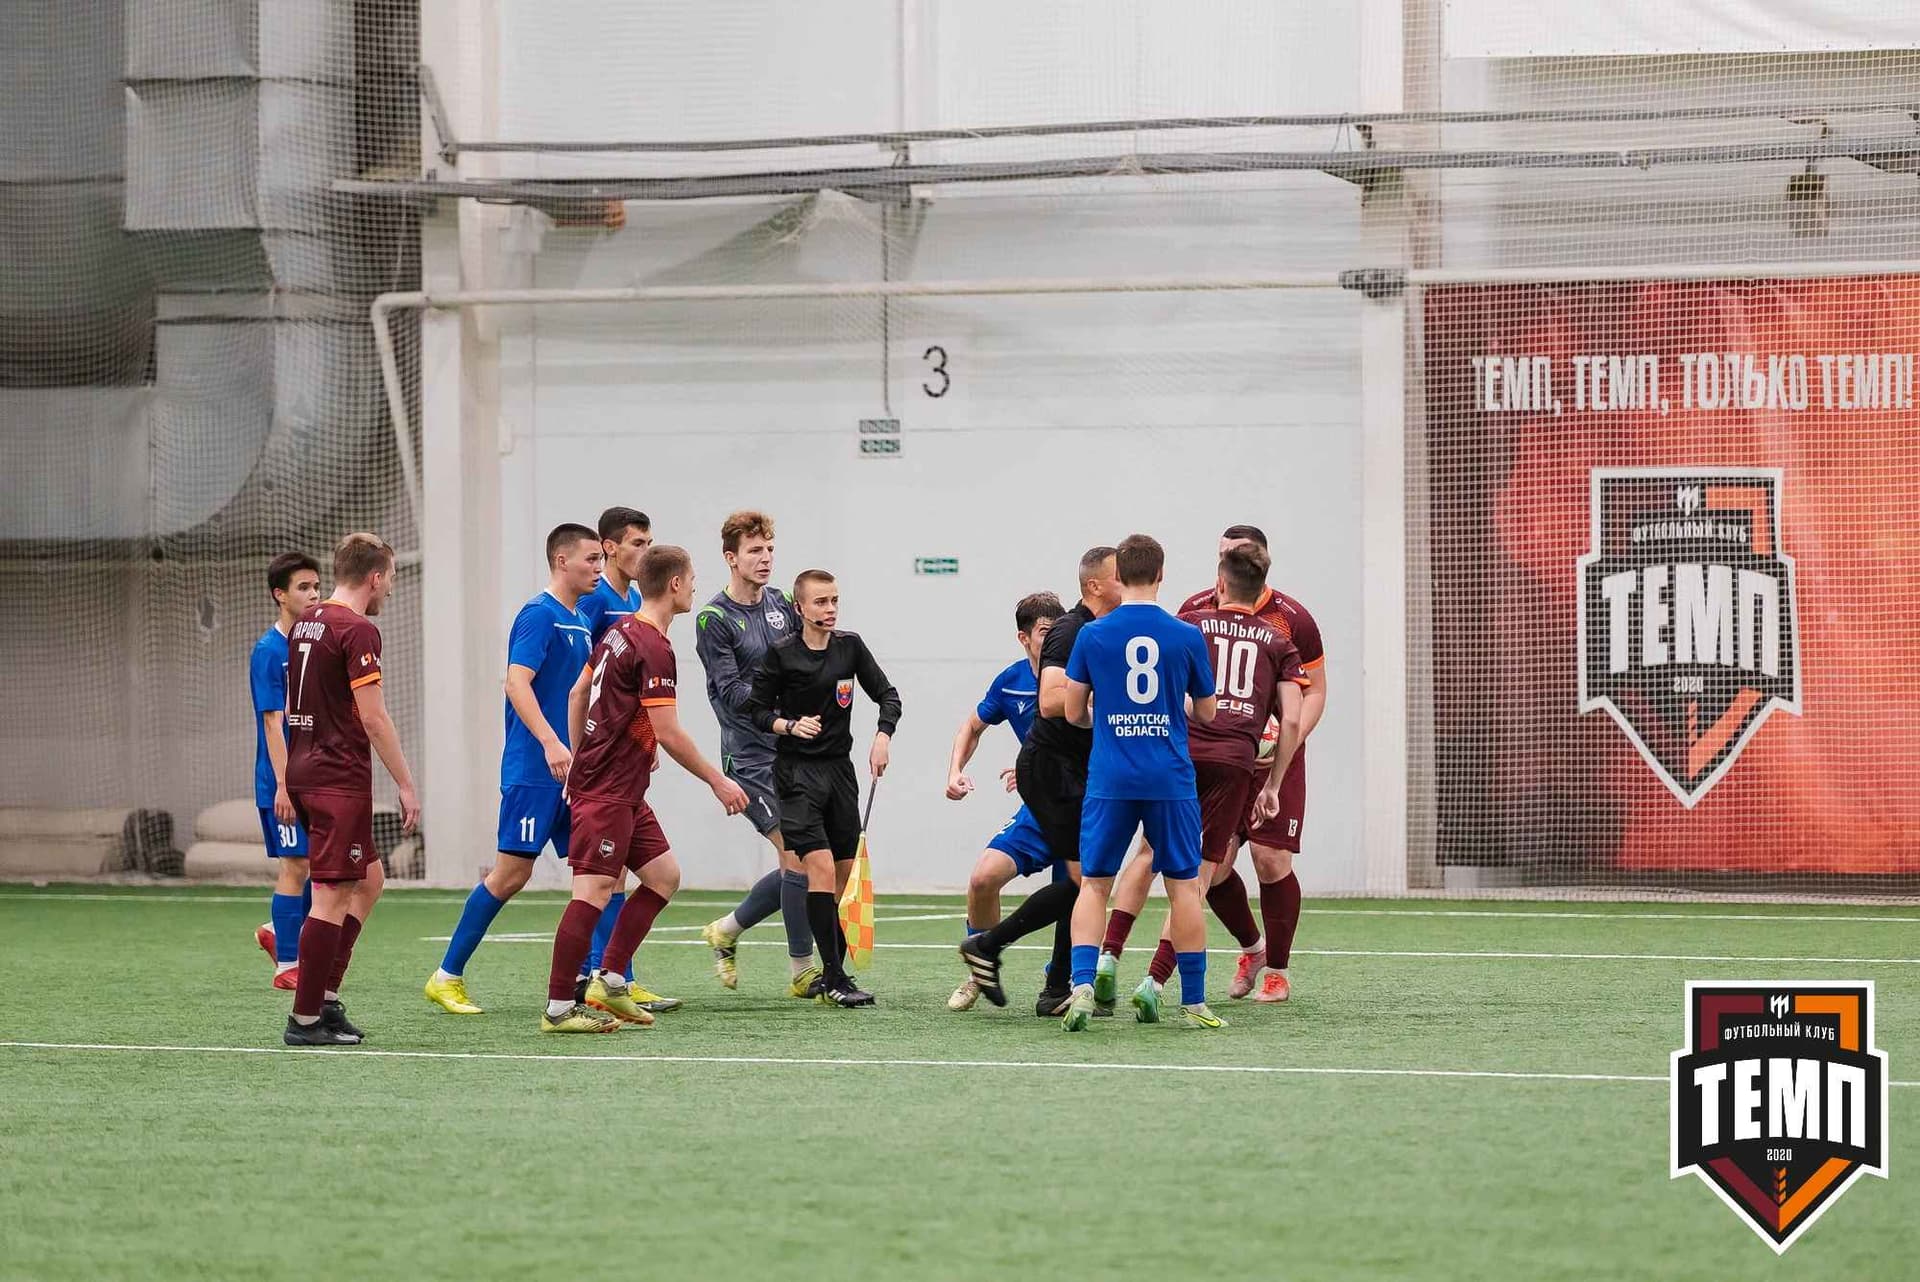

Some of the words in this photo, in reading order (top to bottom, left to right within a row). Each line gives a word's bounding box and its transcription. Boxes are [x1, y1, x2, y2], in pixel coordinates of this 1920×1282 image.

[923, 346, 950, 398] 3
[1472, 355, 1561, 416] ТЕМП,
[1573, 355, 1669, 416] ТЕМП,
[1679, 352, 1808, 410] ТОЛЬКО
[1817, 354, 1913, 410] ТЕМП!
[1201, 619, 1273, 645] АПАЛЬКИН
[1602, 563, 1779, 678] ТЕМП
[297, 642, 312, 710] 7
[1125, 635, 1160, 705] 8
[1214, 636, 1258, 699] 10
[1115, 725, 1169, 737] ОБЛАСТЬ
[278, 823, 298, 848] 30
[520, 816, 536, 843] 11
